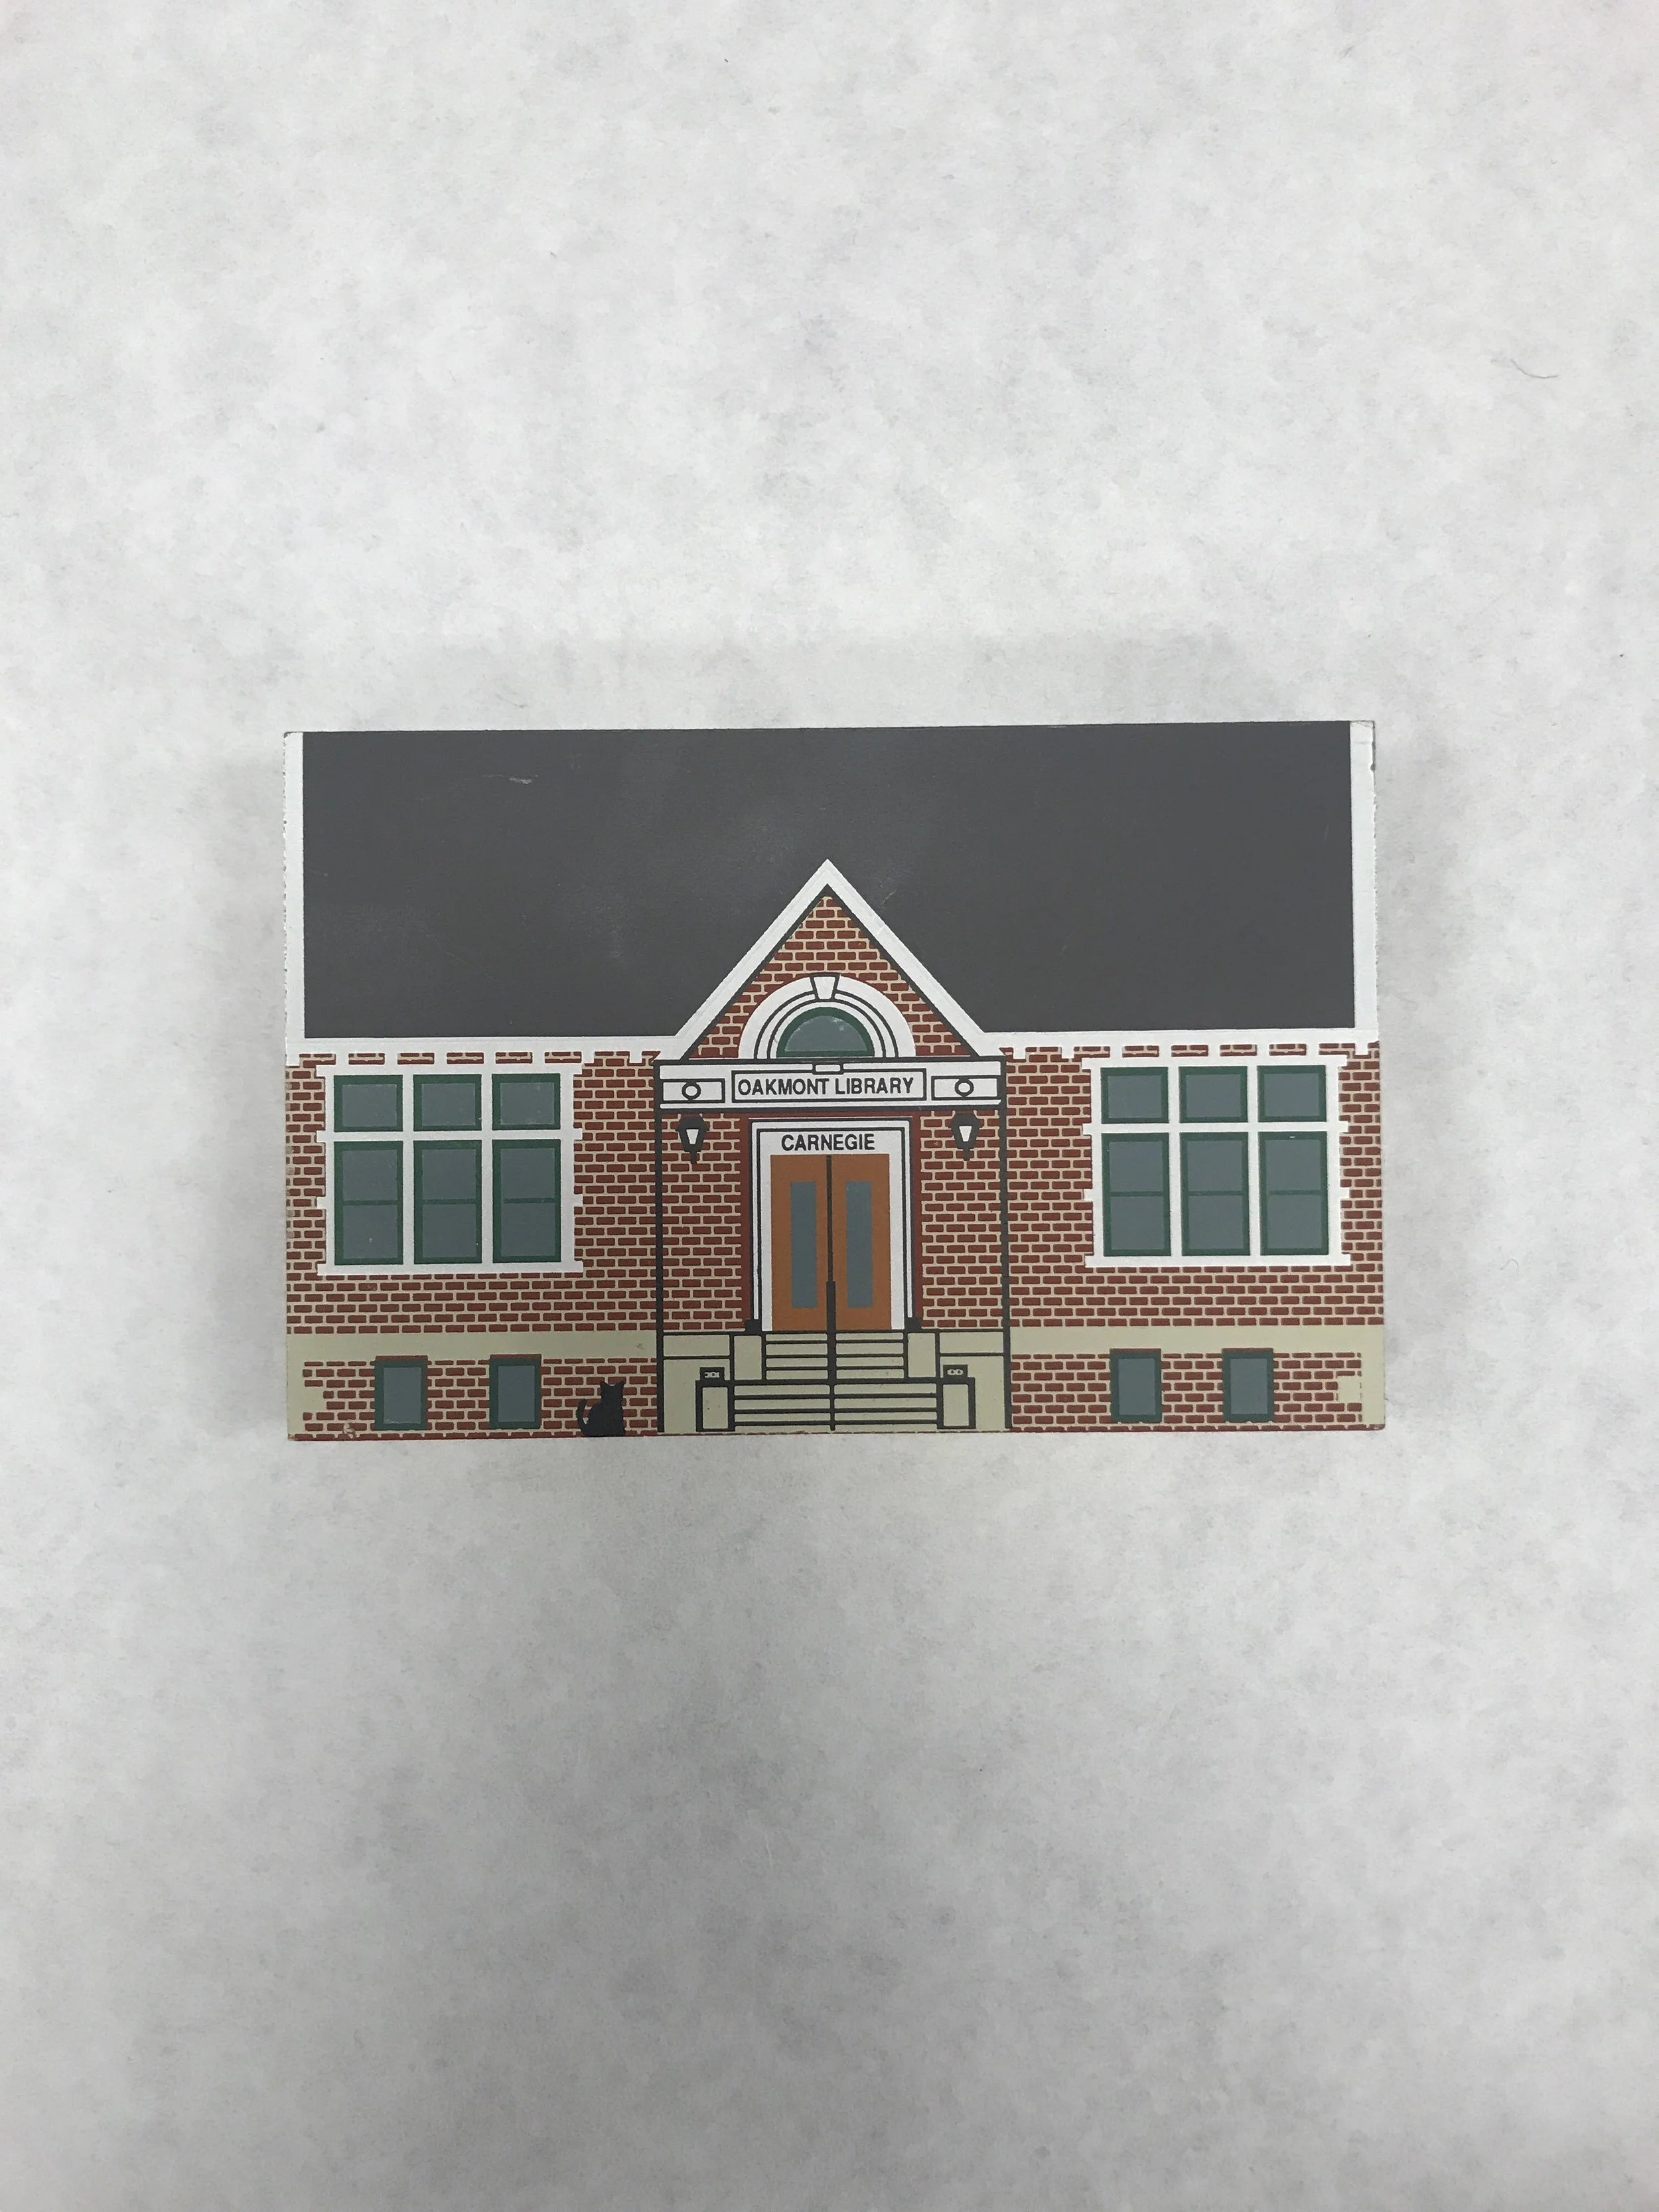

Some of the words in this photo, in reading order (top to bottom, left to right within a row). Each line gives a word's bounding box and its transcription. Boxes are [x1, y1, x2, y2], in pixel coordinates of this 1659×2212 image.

[738, 1078, 829, 1096] OAKMONT
[835, 1076, 914, 1095] LIBRARY
[781, 1134, 875, 1151] CARNEGIE
